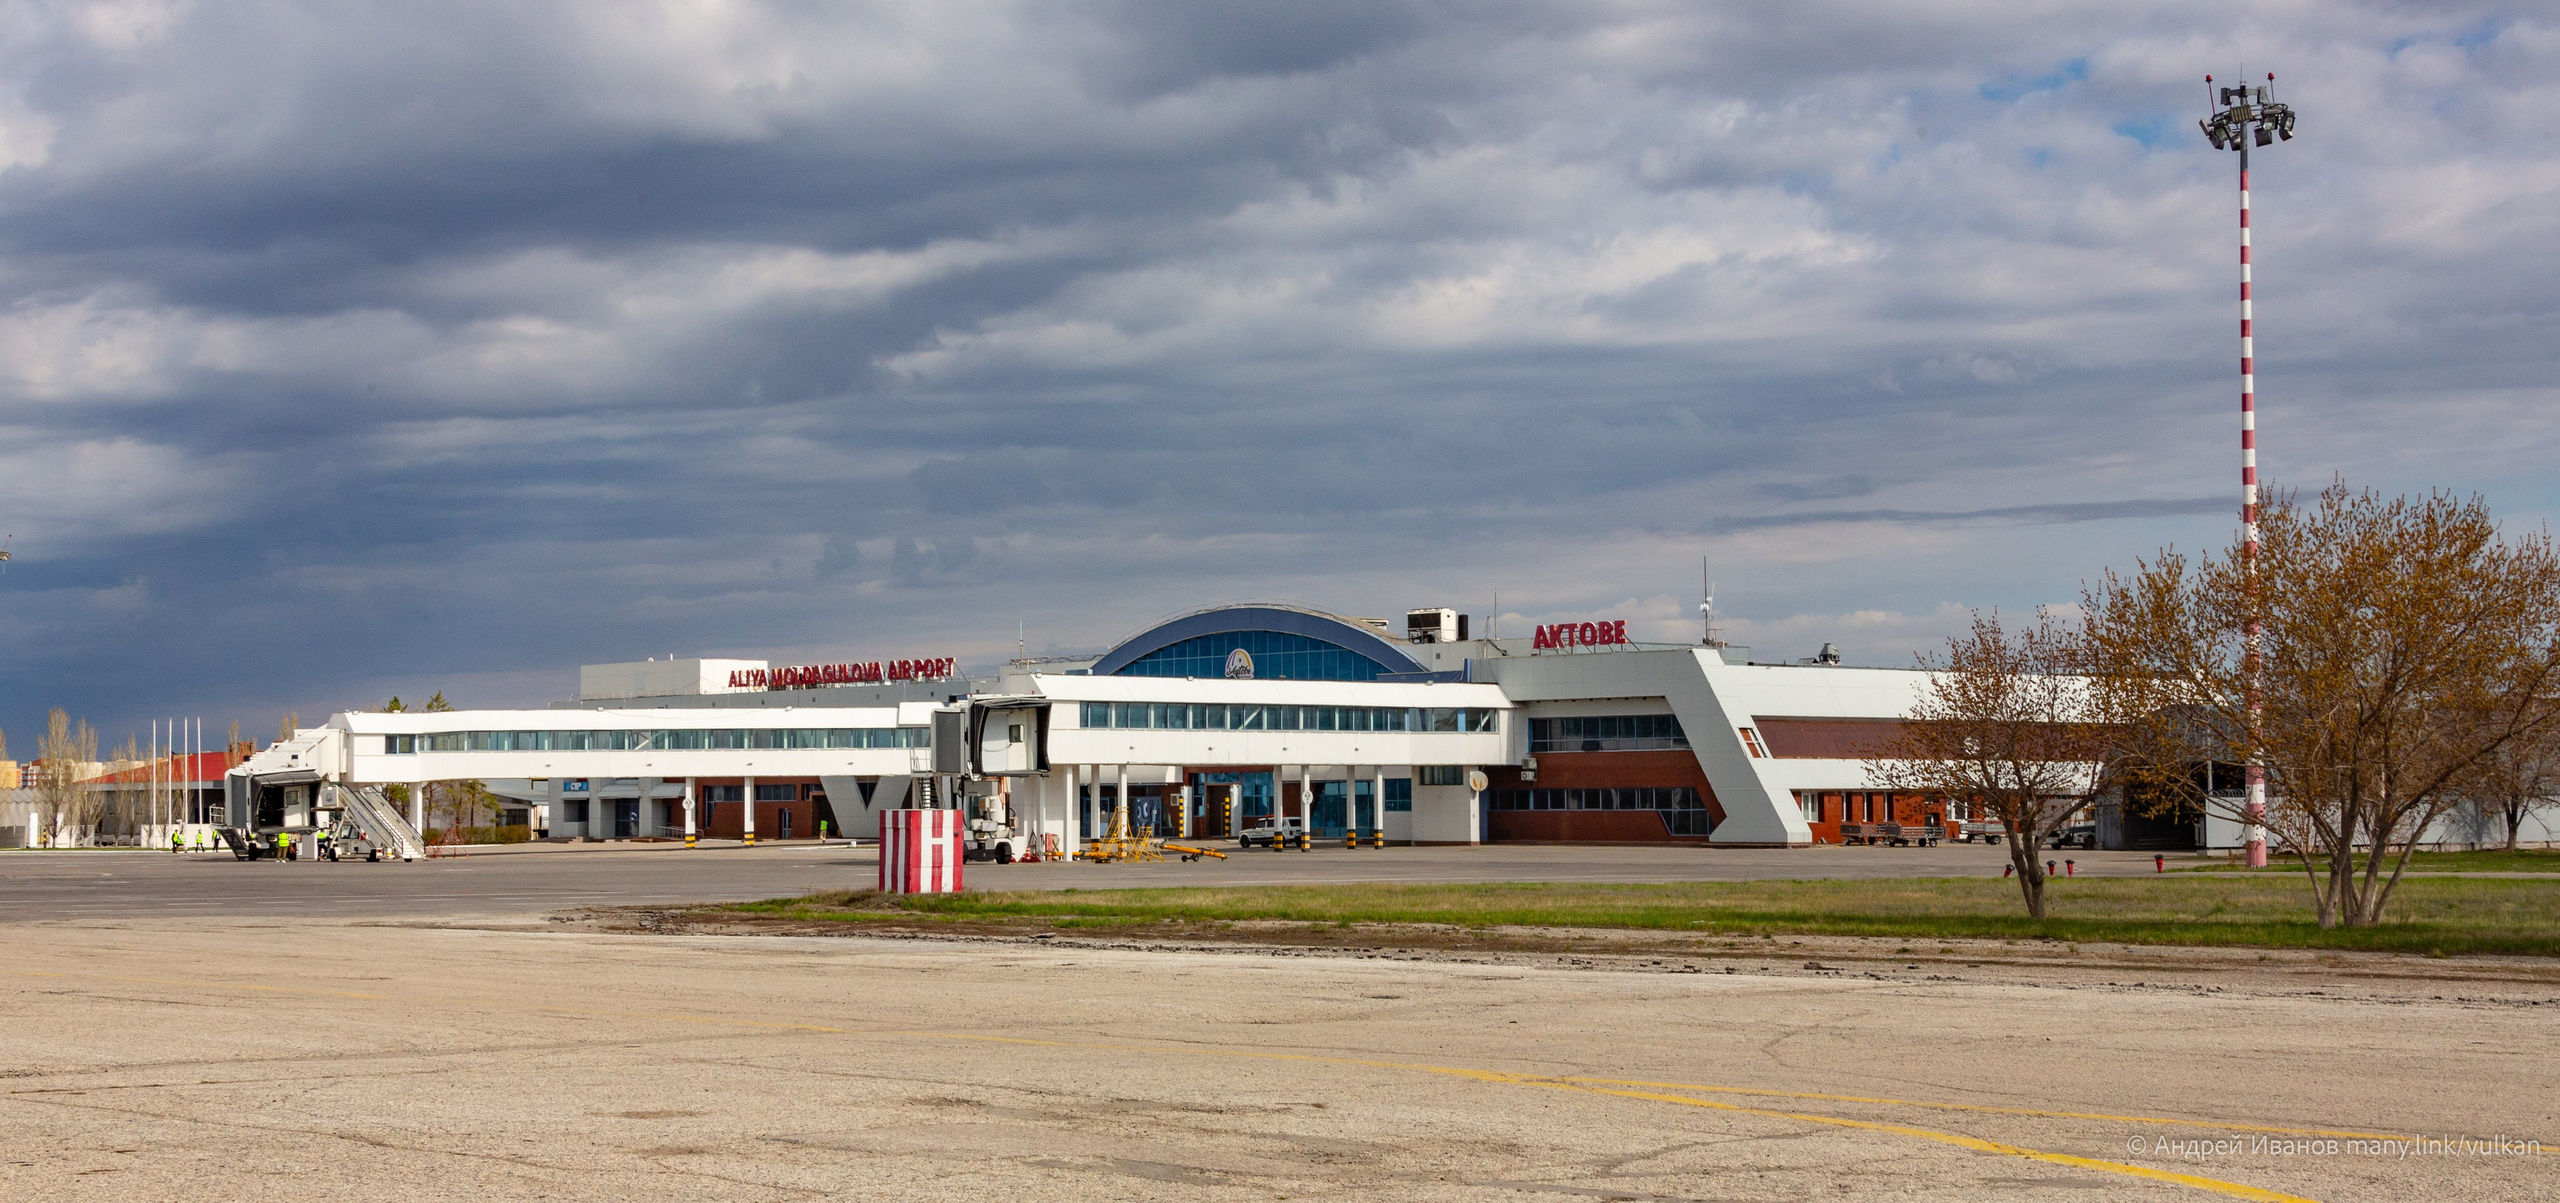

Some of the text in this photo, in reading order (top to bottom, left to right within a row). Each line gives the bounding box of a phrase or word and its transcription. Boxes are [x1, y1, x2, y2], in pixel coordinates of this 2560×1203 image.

[1533, 620, 1628, 649] AKTOBE
[728, 657, 956, 687] ALIYA MOLDAGULOVA AIRPORT
